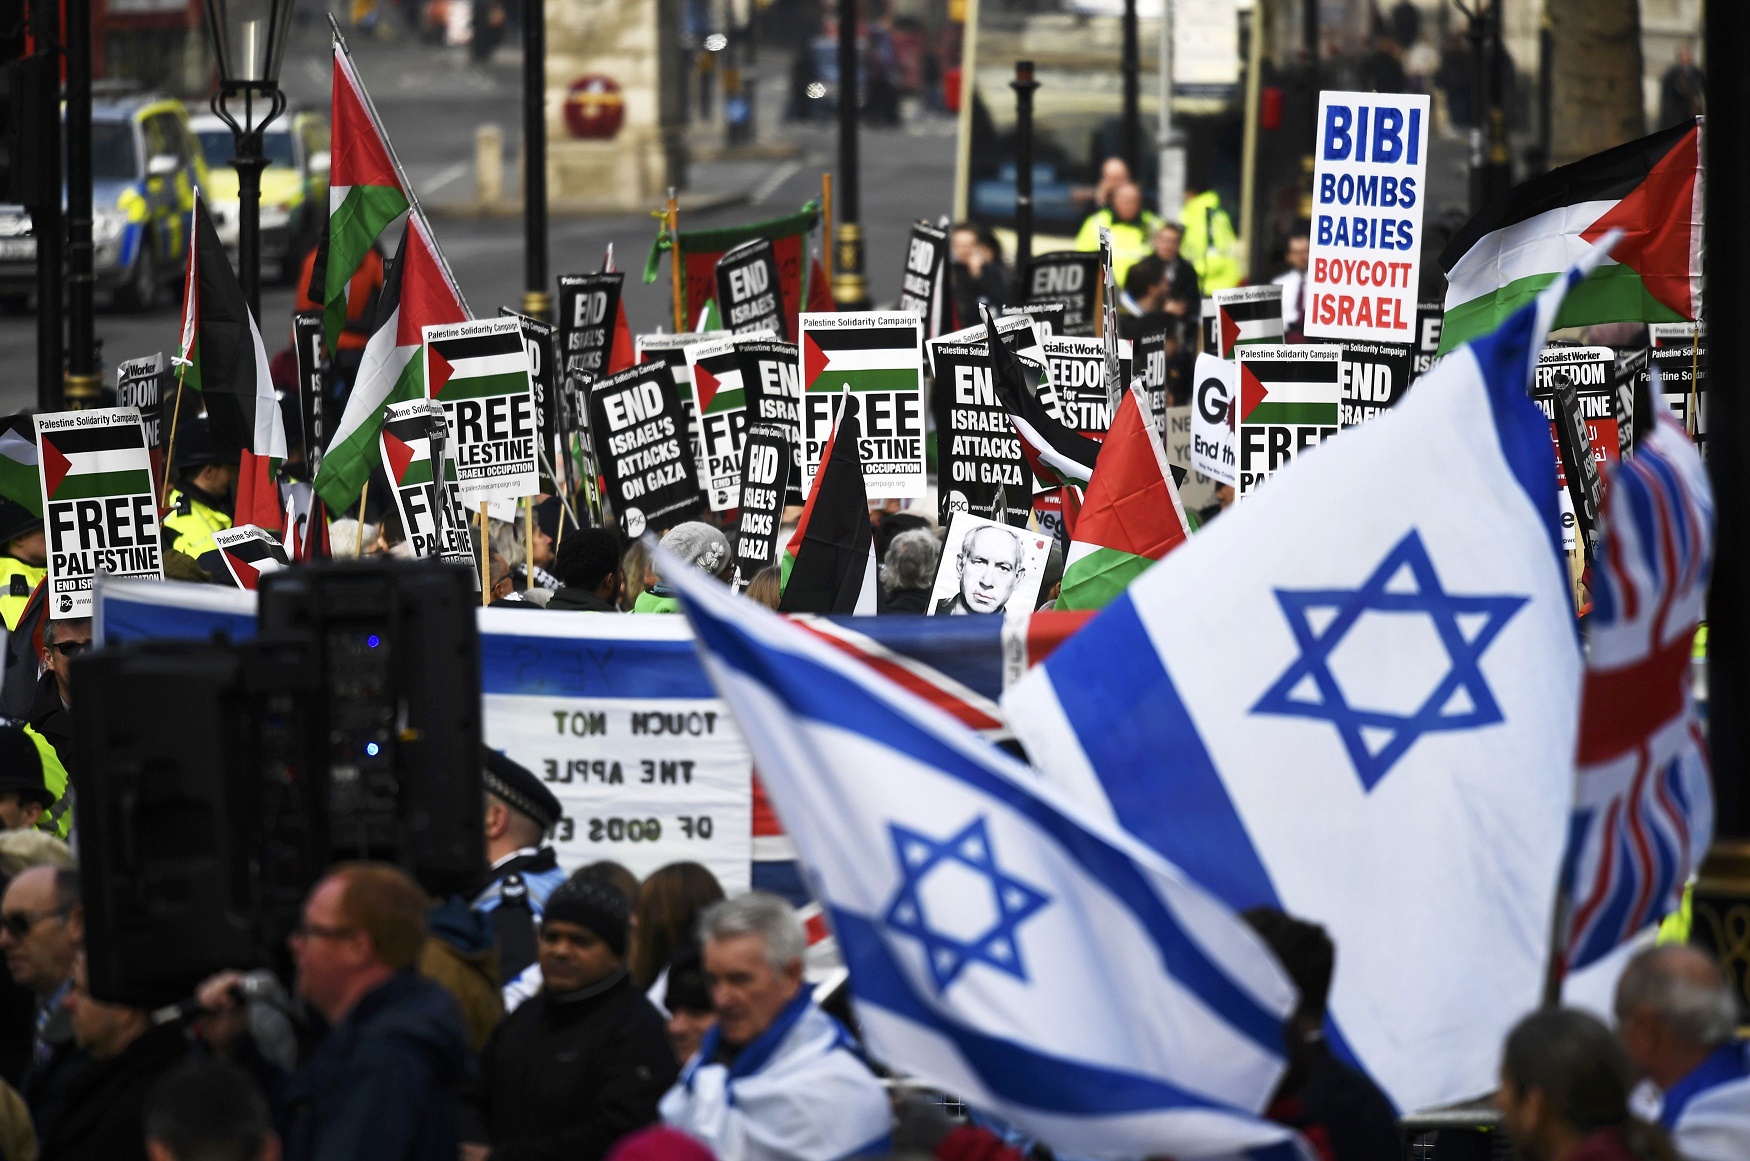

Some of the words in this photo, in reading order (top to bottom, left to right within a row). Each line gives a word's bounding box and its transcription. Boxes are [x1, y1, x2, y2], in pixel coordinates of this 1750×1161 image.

[1323, 105, 1421, 165] BIBI
[1320, 173, 1417, 209] BOMBS
[1317, 215, 1414, 251] BABIES
[729, 259, 769, 303] END
[1033, 264, 1084, 295] END
[1314, 257, 1412, 288] BOYCOTT
[1217, 294, 1244, 302] Palestine
[803, 318, 836, 327] Palestine
[837, 317, 876, 327] Solidarity
[877, 316, 917, 326] Campaign
[1311, 293, 1408, 330] ISRAEL
[427, 328, 460, 339] Palestine
[460, 325, 493, 336] Solidarity
[963, 330, 988, 342] Solidar
[996, 317, 1030, 333] Campaign
[739, 344, 771, 352] Palestine
[771, 344, 798, 356] Solidarity
[937, 346, 968, 355] Palestine
[969, 346, 989, 356] Solidar
[1043, 342, 1073, 353] cialist
[1074, 343, 1104, 355] Work
[1240, 350, 1275, 358] Palestine
[1276, 350, 1309, 359] Solidarity
[1309, 350, 1339, 360] Campaign
[1350, 343, 1379, 355] Solidarity
[1379, 346, 1407, 357] Campaign
[1538, 351, 1571, 363] Socialist
[1571, 350, 1601, 361] Worker
[1652, 348, 1682, 358] Palestine
[130, 363, 156, 377] Worker
[614, 369, 639, 383] Solidarity
[638, 360, 666, 375] Campaign
[759, 360, 800, 399] EN
[954, 365, 1002, 406] EN
[1341, 360, 1392, 403] END
[1063, 387, 1077, 400] for
[603, 381, 664, 432] END
[39, 419, 75, 429] Palestine
[76, 415, 110, 425] Solidarity
[112, 412, 140, 423] Campaign
[608, 416, 675, 456] ISRAEL'S
[457, 438, 534, 467] LESTINE
[806, 439, 921, 461] PSTINE
[951, 435, 1022, 460] ATTACKS
[1194, 433, 1219, 460] End
[1222, 445, 1235, 466] th
[617, 439, 681, 479] ATTACKS
[865, 463, 921, 474] OCCUPATION
[457, 466, 485, 480] SRAELI
[487, 462, 533, 476] OCCUPATION
[622, 477, 646, 500] ON
[646, 462, 687, 492] GAZA
[952, 461, 977, 482] ON
[981, 462, 1024, 485] GAZA
[713, 478, 731, 489] END
[950, 501, 967, 511] PSC
[48, 496, 157, 552] FREE
[629, 514, 646, 527] PSC
[216, 533, 245, 545] Palestine
[52, 546, 159, 577] PALESTINE
[56, 580, 76, 592] END
[61, 599, 73, 607] PSC
